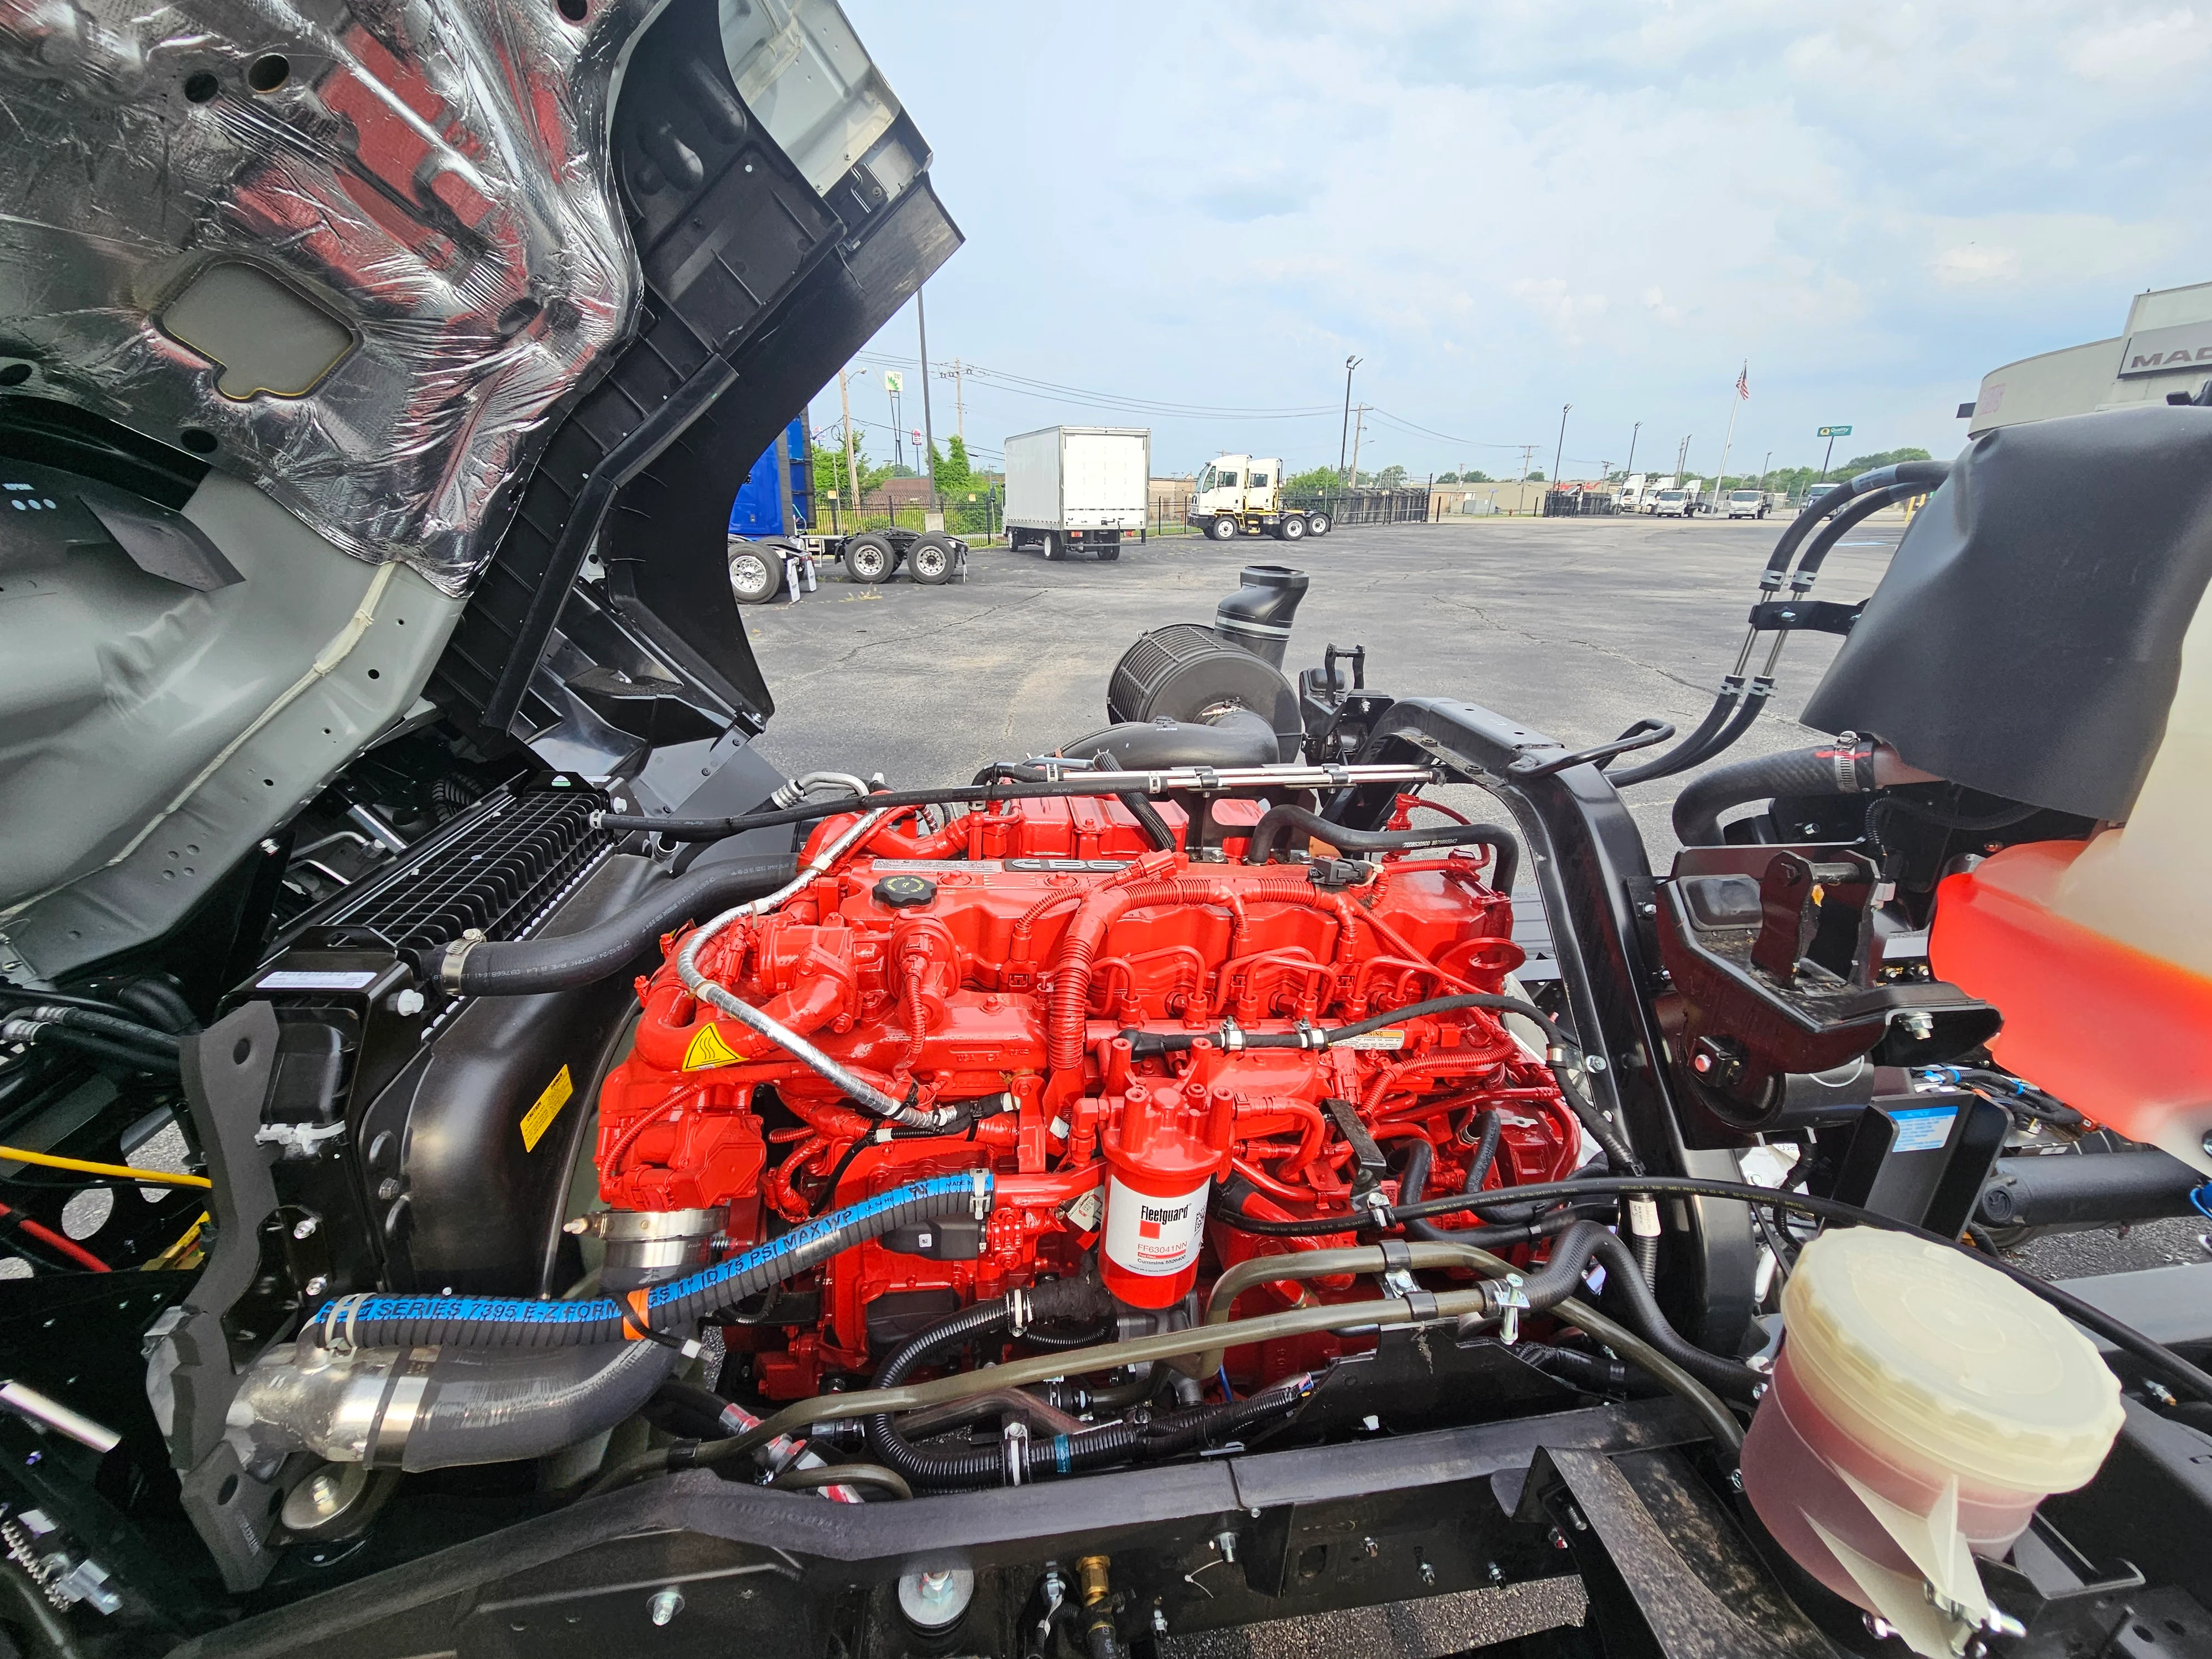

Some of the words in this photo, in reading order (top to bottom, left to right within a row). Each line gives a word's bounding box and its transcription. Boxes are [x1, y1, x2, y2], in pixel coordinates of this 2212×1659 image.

[526, 1100, 541, 1121] CAUTION
[1488, 1126, 1496, 1141] FUEL
[1140, 1204, 1188, 1225] Fleetguard
[377, 1302, 462, 1317] SERIES
[470, 1303, 518, 1318] 7395
[523, 1305, 559, 1319] E-Z
[563, 1303, 620, 1319] FORM
[701, 1270, 719, 1287] ID
[724, 1258, 744, 1277] 75
[750, 1243, 778, 1262] PSI
[783, 1223, 820, 1250] MAX
[825, 1210, 853, 1229] WP
[946, 1180, 966, 1188] MADE
[1137, 1240, 1188, 1253] FF63041NN
